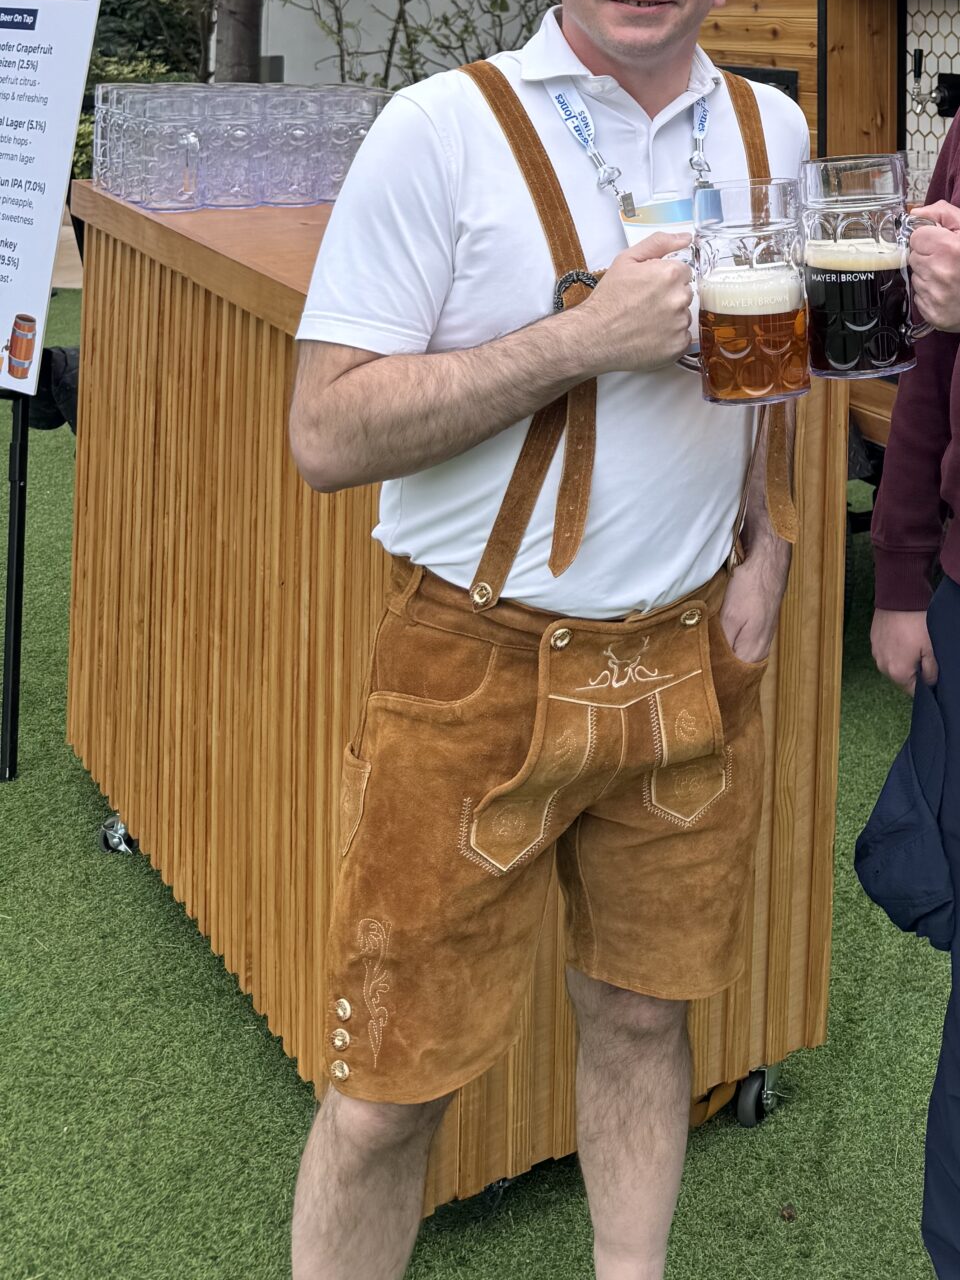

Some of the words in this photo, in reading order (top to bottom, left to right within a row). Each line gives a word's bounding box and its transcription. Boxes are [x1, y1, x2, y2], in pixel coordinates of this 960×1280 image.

[0, 12, 13, 22] Beer
[13, 13, 23, 23] On
[23, 14, 34, 25] Tap
[16, 42, 53, 56] Grapefruit
[17, 59, 39, 73] (2.5%)
[16, 92, 49, 106] refreshing
[5, 117, 26, 130] Lager
[26, 119, 47, 134] (5.1%)
[13, 135, 29, 147] hops
[0, 177, 10, 188] un
[10, 178, 23, 190] IPA
[24, 179, 46, 195] (7.0%)
